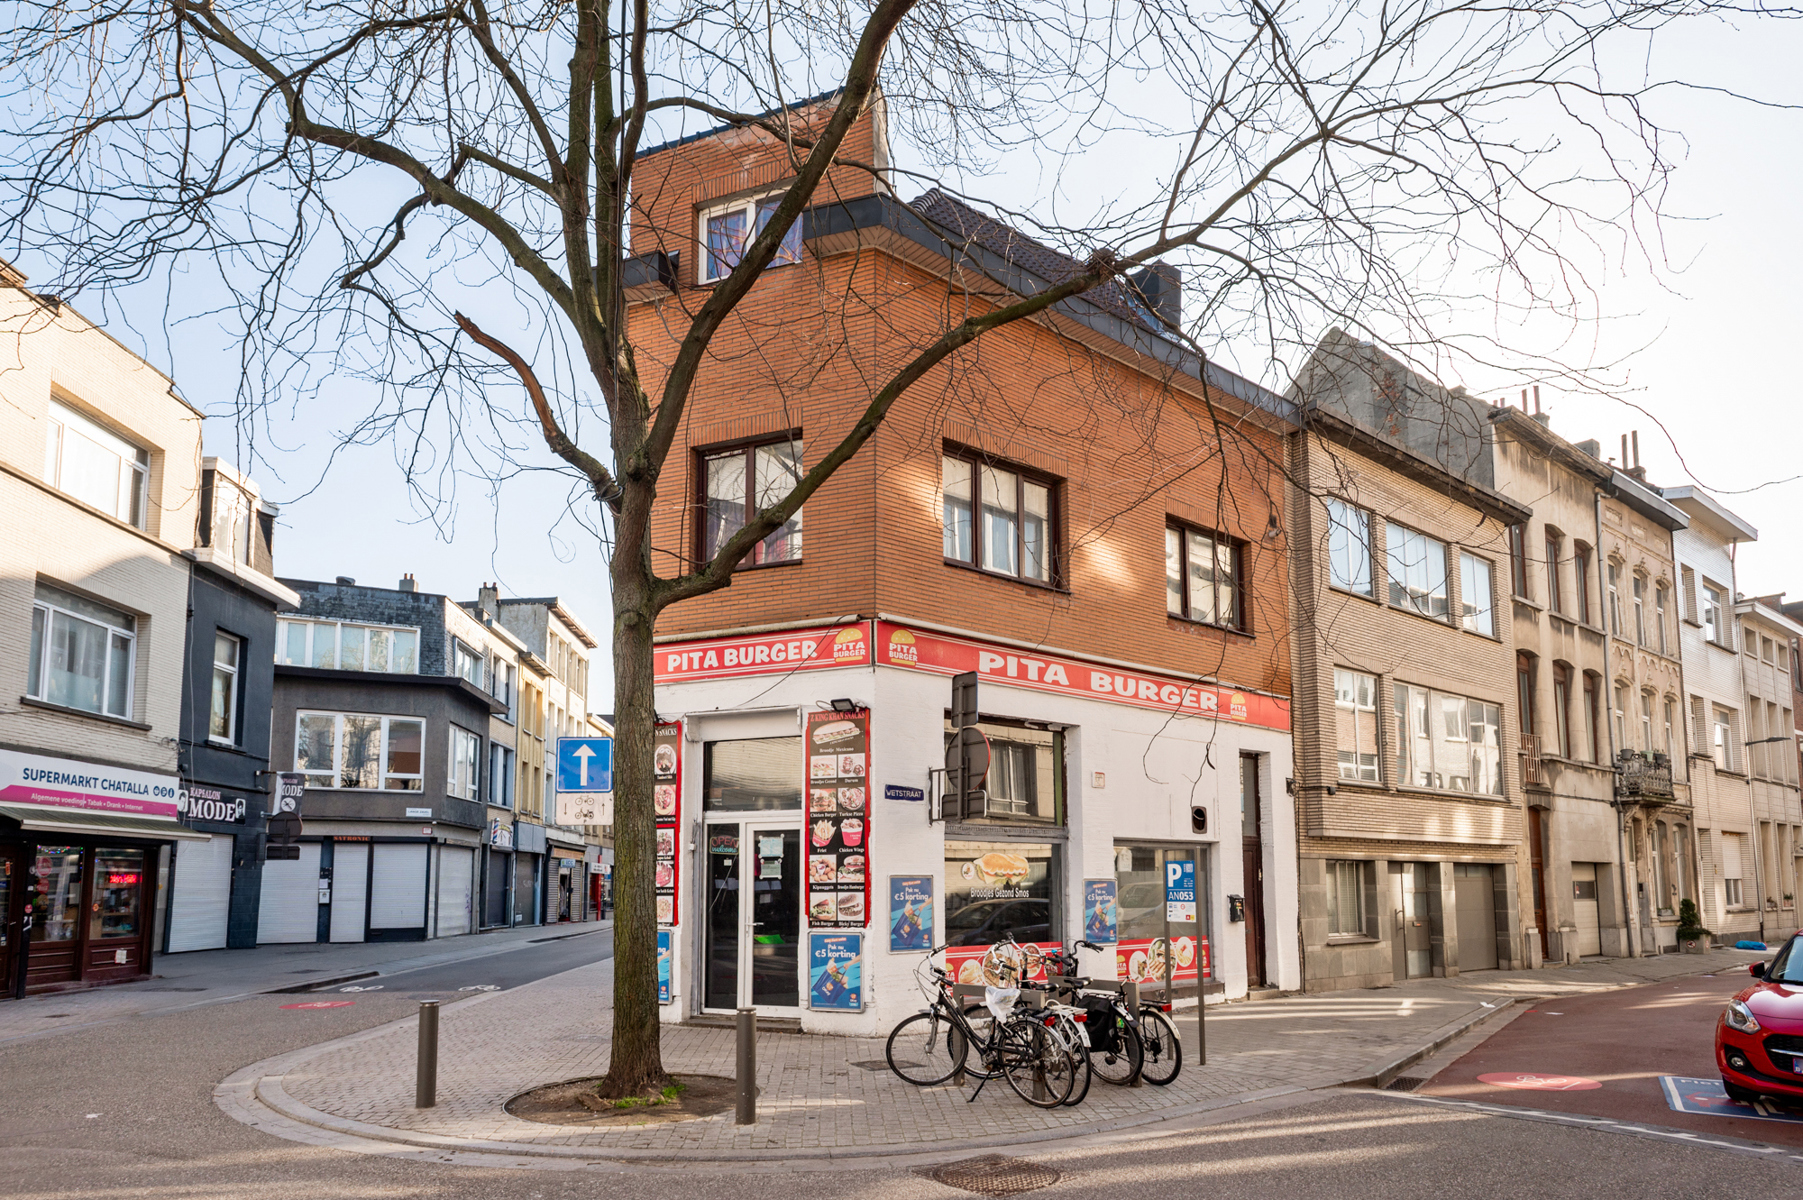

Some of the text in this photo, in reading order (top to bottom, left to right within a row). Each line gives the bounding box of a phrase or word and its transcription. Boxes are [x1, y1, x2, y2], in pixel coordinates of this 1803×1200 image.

[834, 642, 865, 651] PITA
[889, 643, 917, 654] PITA
[668, 640, 817, 672] PITA BURGER
[834, 649, 866, 658] BURGER
[889, 651, 918, 662] BURGER
[979, 651, 1219, 710] PITA BURGER
[1230, 703, 1246, 712] PITA
[829, 712, 844, 720] KHAN
[844, 711, 865, 719] SNACKS
[659, 728, 676, 736] SNACKS
[23, 767, 149, 795] SUPERMARKT CHATALLA
[190, 787, 221, 800] KAPSALON
[31, 793, 60, 803] Algemene
[61, 797, 84, 806] voeding
[188, 798, 235, 822] MODE
[712, 836, 738, 848] OPEN
[1167, 864, 1182, 887] P
[894, 892, 928, 902] €5 korting
[970, 887, 1029, 900] Broodjes Gezond Smos
[1169, 892, 1194, 900] AN053
[815, 949, 856, 959] €5 korting
